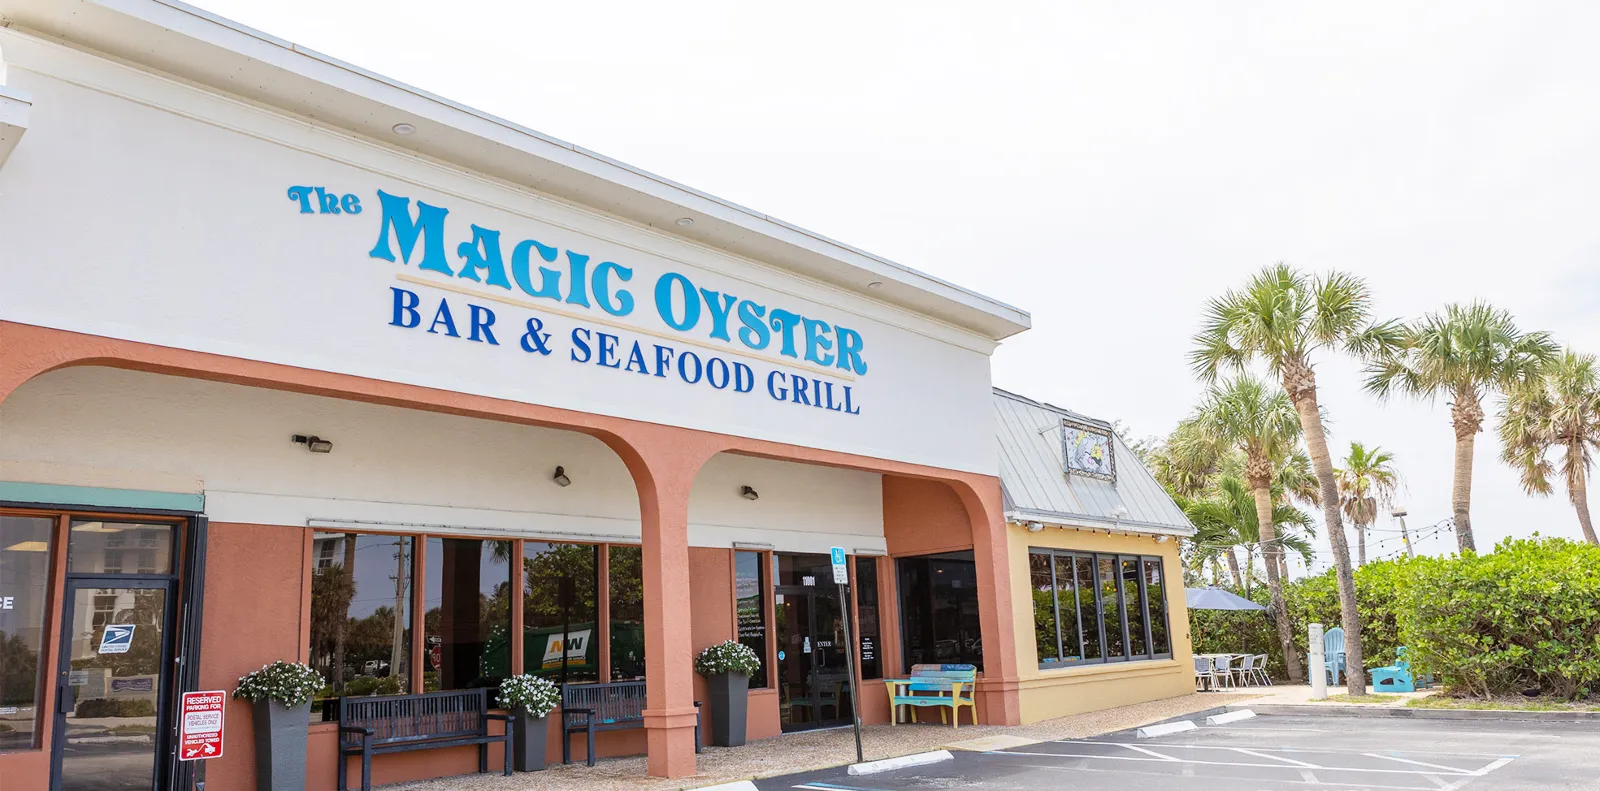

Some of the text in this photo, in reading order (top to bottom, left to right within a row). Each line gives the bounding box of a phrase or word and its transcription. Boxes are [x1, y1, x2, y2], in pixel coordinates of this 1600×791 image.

[287, 184, 869, 376] The MAGIC OYSTER
[388, 286, 862, 416] BAR & SEAFOOD GRILL
[186, 696, 222, 704] RESERVED
